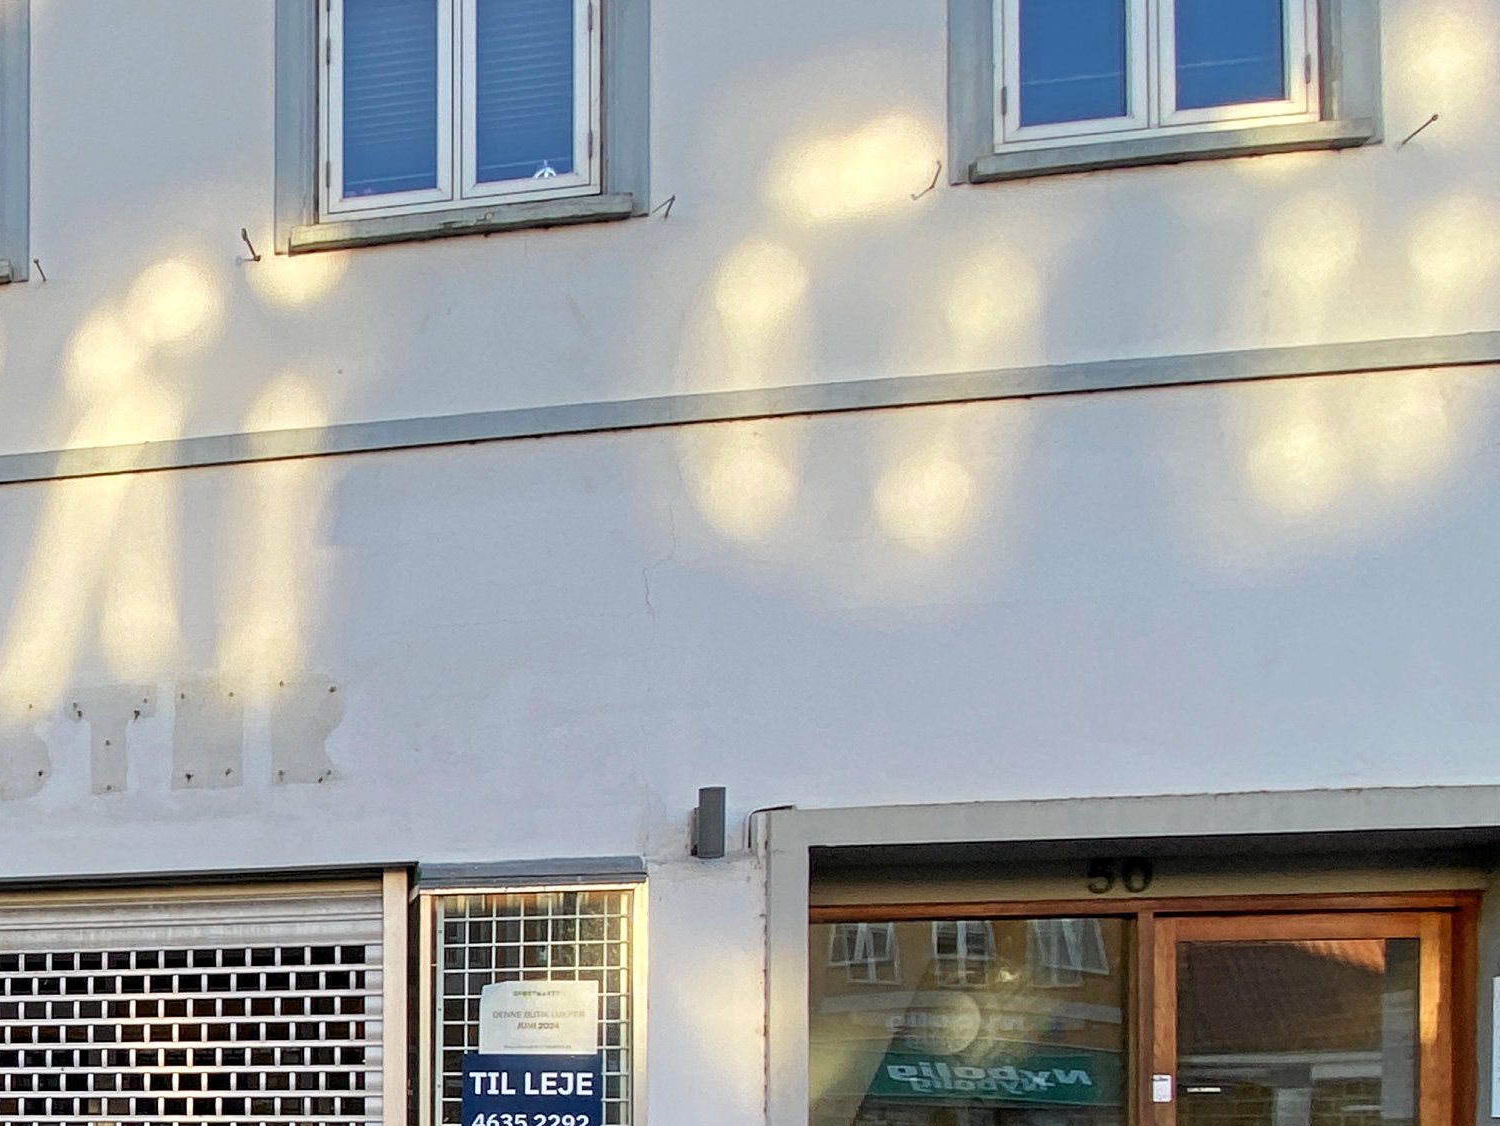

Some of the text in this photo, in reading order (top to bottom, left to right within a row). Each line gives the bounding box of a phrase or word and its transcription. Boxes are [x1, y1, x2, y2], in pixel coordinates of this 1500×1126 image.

[1087, 857, 1153, 894] 50
[538, 1022, 560, 1030] 2024
[469, 1071, 593, 1095] TIL LEJE
